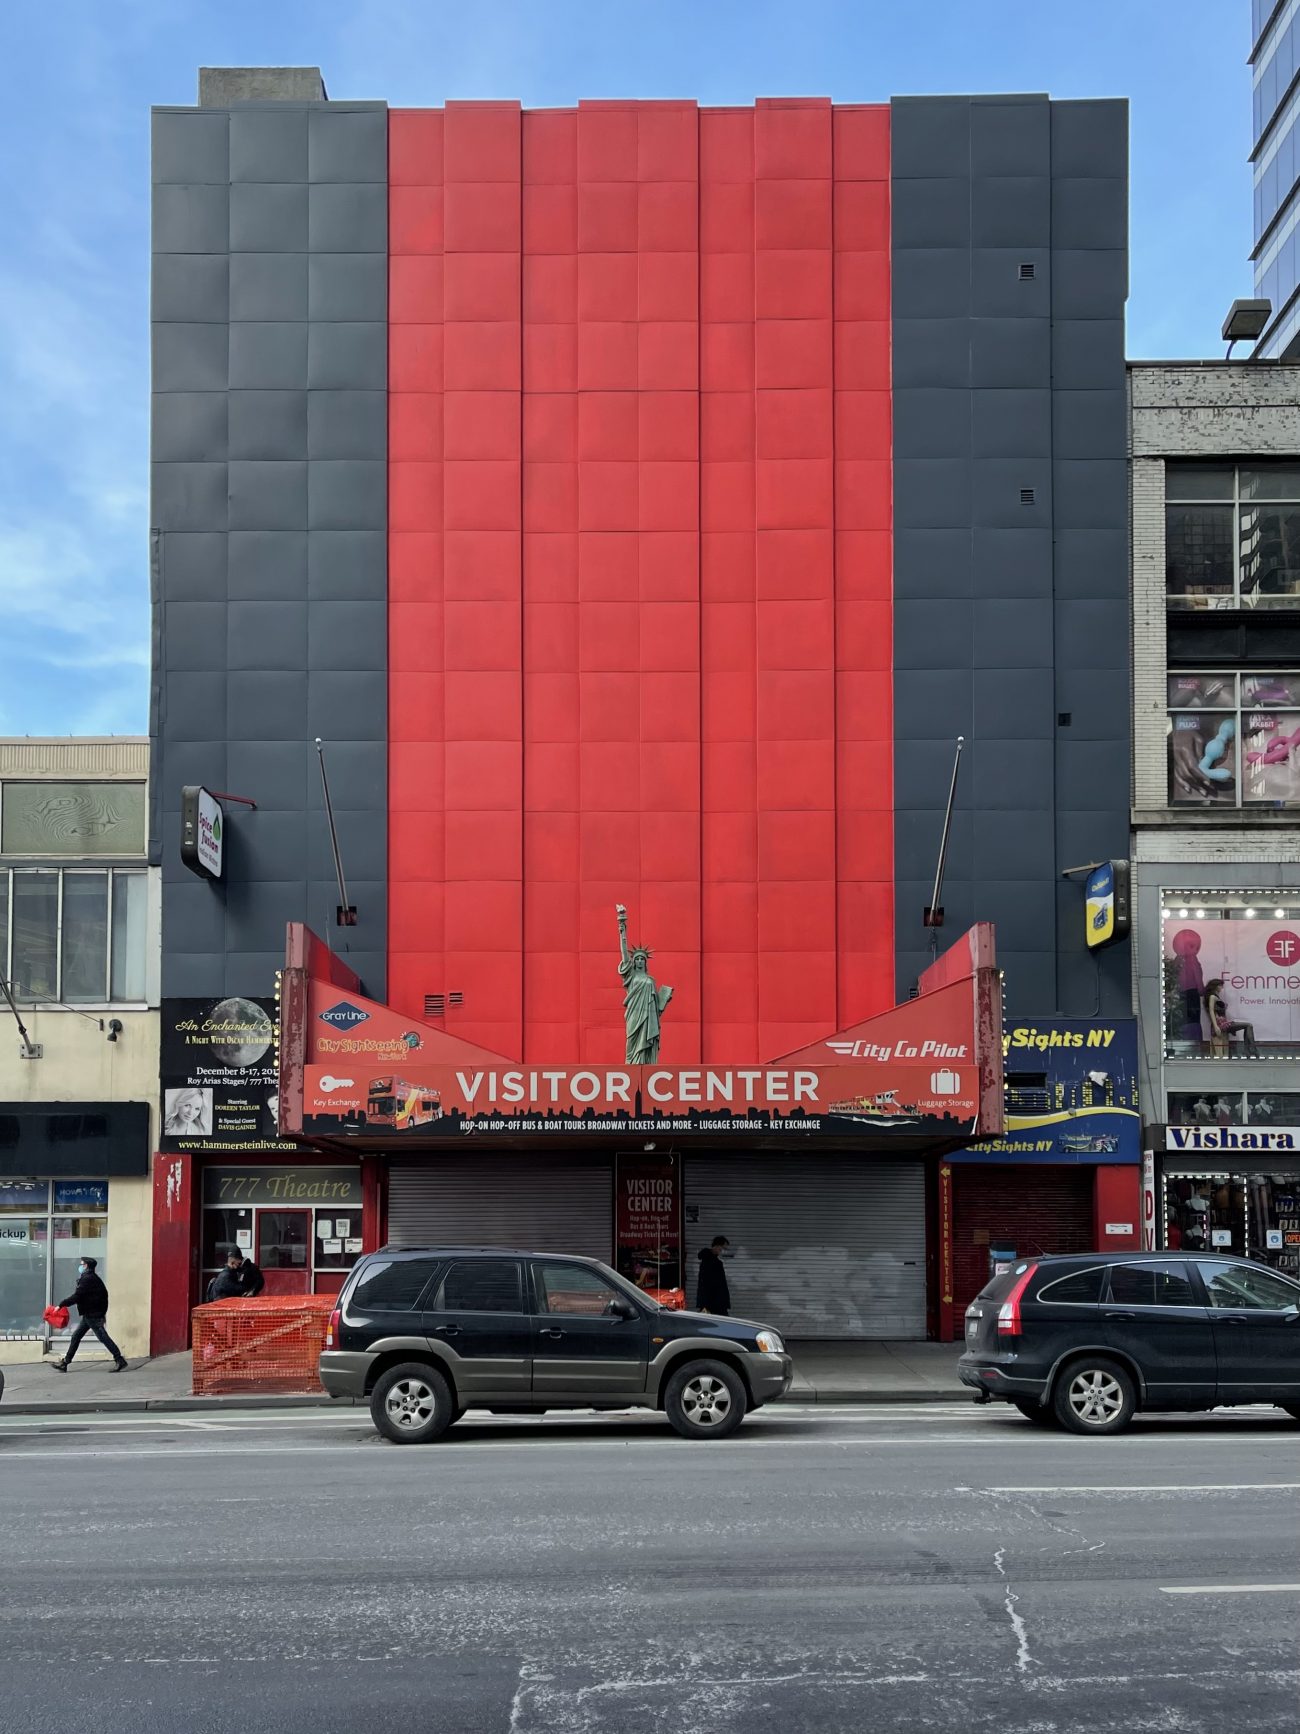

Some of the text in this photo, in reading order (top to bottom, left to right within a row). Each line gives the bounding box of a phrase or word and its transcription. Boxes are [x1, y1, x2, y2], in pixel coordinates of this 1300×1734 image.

[1221, 971, 1300, 989] Femme
[175, 1020, 198, 1031] An
[202, 1019, 258, 1031] Enchanted
[316, 1038, 410, 1053] City Sightseeing
[1086, 1029, 1115, 1047] NY
[852, 1040, 968, 1061] City Co Pilot
[196, 1066, 238, 1076] December
[240, 1067, 260, 1077] 8-17,
[187, 1078, 201, 1086] Roy
[222, 1078, 248, 1086] Stages/
[456, 1071, 819, 1102] VISITOR CENTER
[313, 1099, 361, 1108] Key Exchange
[918, 1099, 974, 1109] Luggage Storage
[460, 1120, 488, 1130] HOP-ON
[490, 1120, 520, 1130] HOP-OFF
[522, 1120, 536, 1130] BUS
[538, 1120, 543, 1130] &
[544, 1120, 562, 1130] BOAT
[564, 1120, 586, 1130] TOURS
[587, 1120, 626, 1130] BROADWAY
[628, 1120, 655, 1130] TICKETS
[656, 1120, 671, 1130] AND
[672, 1120, 692, 1130] MORE
[699, 1120, 730, 1130] LUGGAGE
[732, 1120, 762, 1130] STORAGE
[770, 1120, 783, 1130] KEY
[784, 1120, 821, 1130] EXCHANGE
[178, 1139, 298, 1150] www.hammersteinlive.com
[1170, 1126, 1296, 1149] Vishara
[1035, 1140, 1053, 1151] NY
[219, 1174, 351, 1198] 777 Theatre
[626, 1179, 673, 1194] VISITOR
[628, 1196, 672, 1212] CENTER
